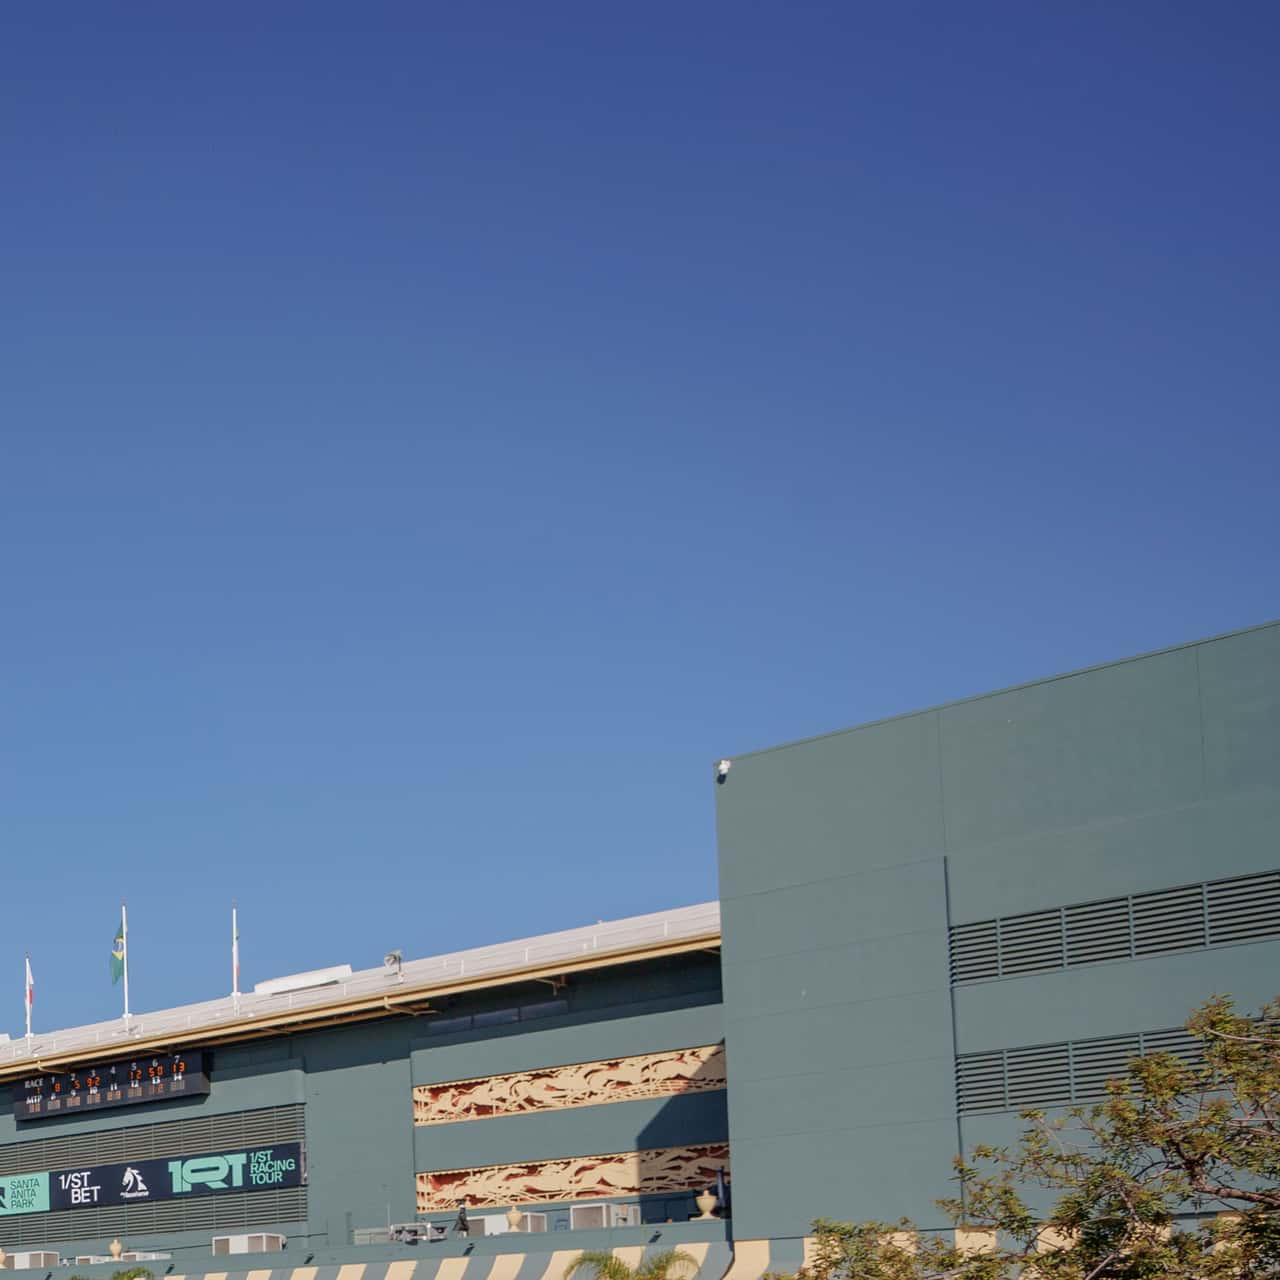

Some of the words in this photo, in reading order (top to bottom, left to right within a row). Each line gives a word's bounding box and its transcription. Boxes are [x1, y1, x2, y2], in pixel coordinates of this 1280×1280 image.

[249, 1150, 274, 1163] 1/ST
[250, 1159, 296, 1174] RACING
[10, 1178, 40, 1189] SANTA
[58, 1172, 91, 1190] 1/ST
[250, 1172, 283, 1185] TOUR
[10, 1188, 37, 1199] ANITA
[71, 1186, 101, 1204] BET
[10, 1198, 35, 1209] PARK
